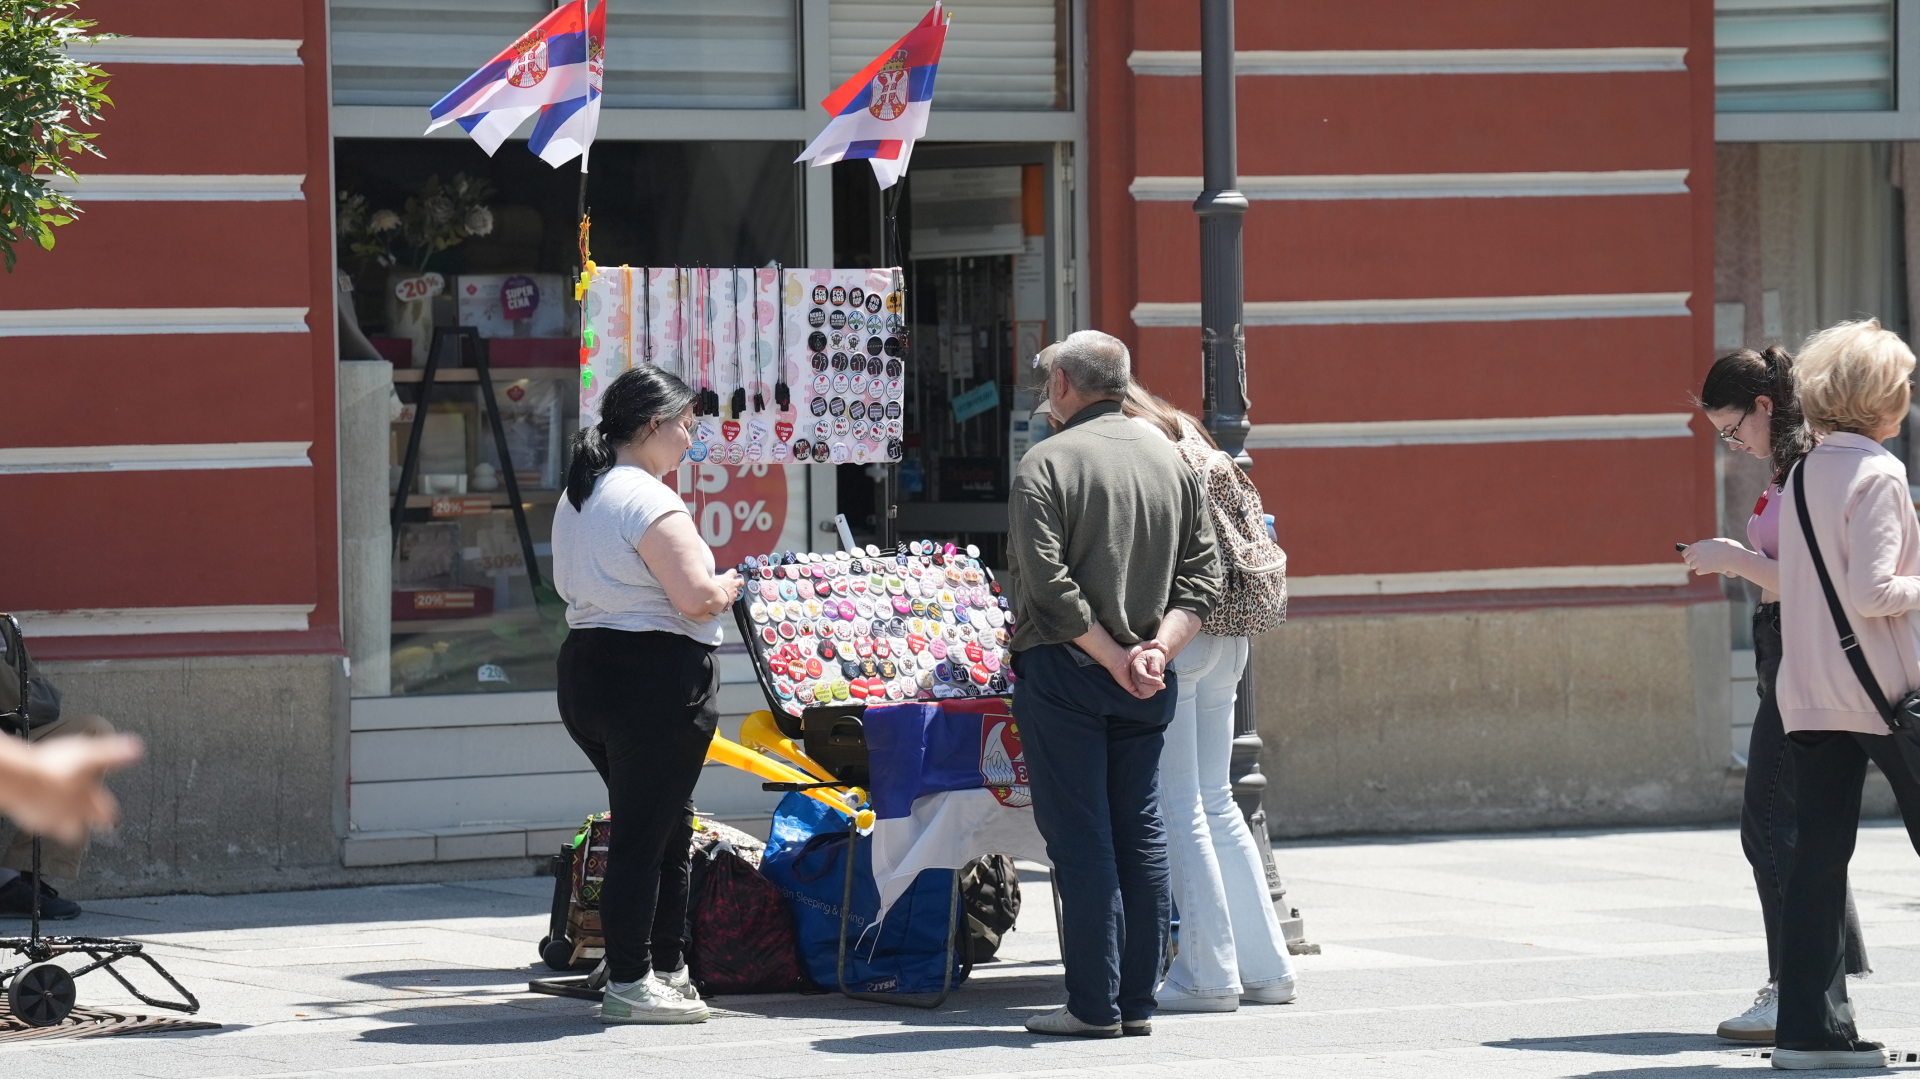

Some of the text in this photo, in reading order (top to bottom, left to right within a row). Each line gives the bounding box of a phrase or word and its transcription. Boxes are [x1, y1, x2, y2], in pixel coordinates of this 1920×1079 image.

[398, 276, 438, 298] -20%
[505, 285, 534, 300] SUPER
[508, 297, 530, 310] CENA
[434, 501, 461, 514] -20%
[686, 500, 773, 547] 0%
[415, 594, 443, 606] -20%
[796, 891, 831, 915] Sleeping
[832, 904, 839, 915] &
[873, 980, 896, 991] JYSK
